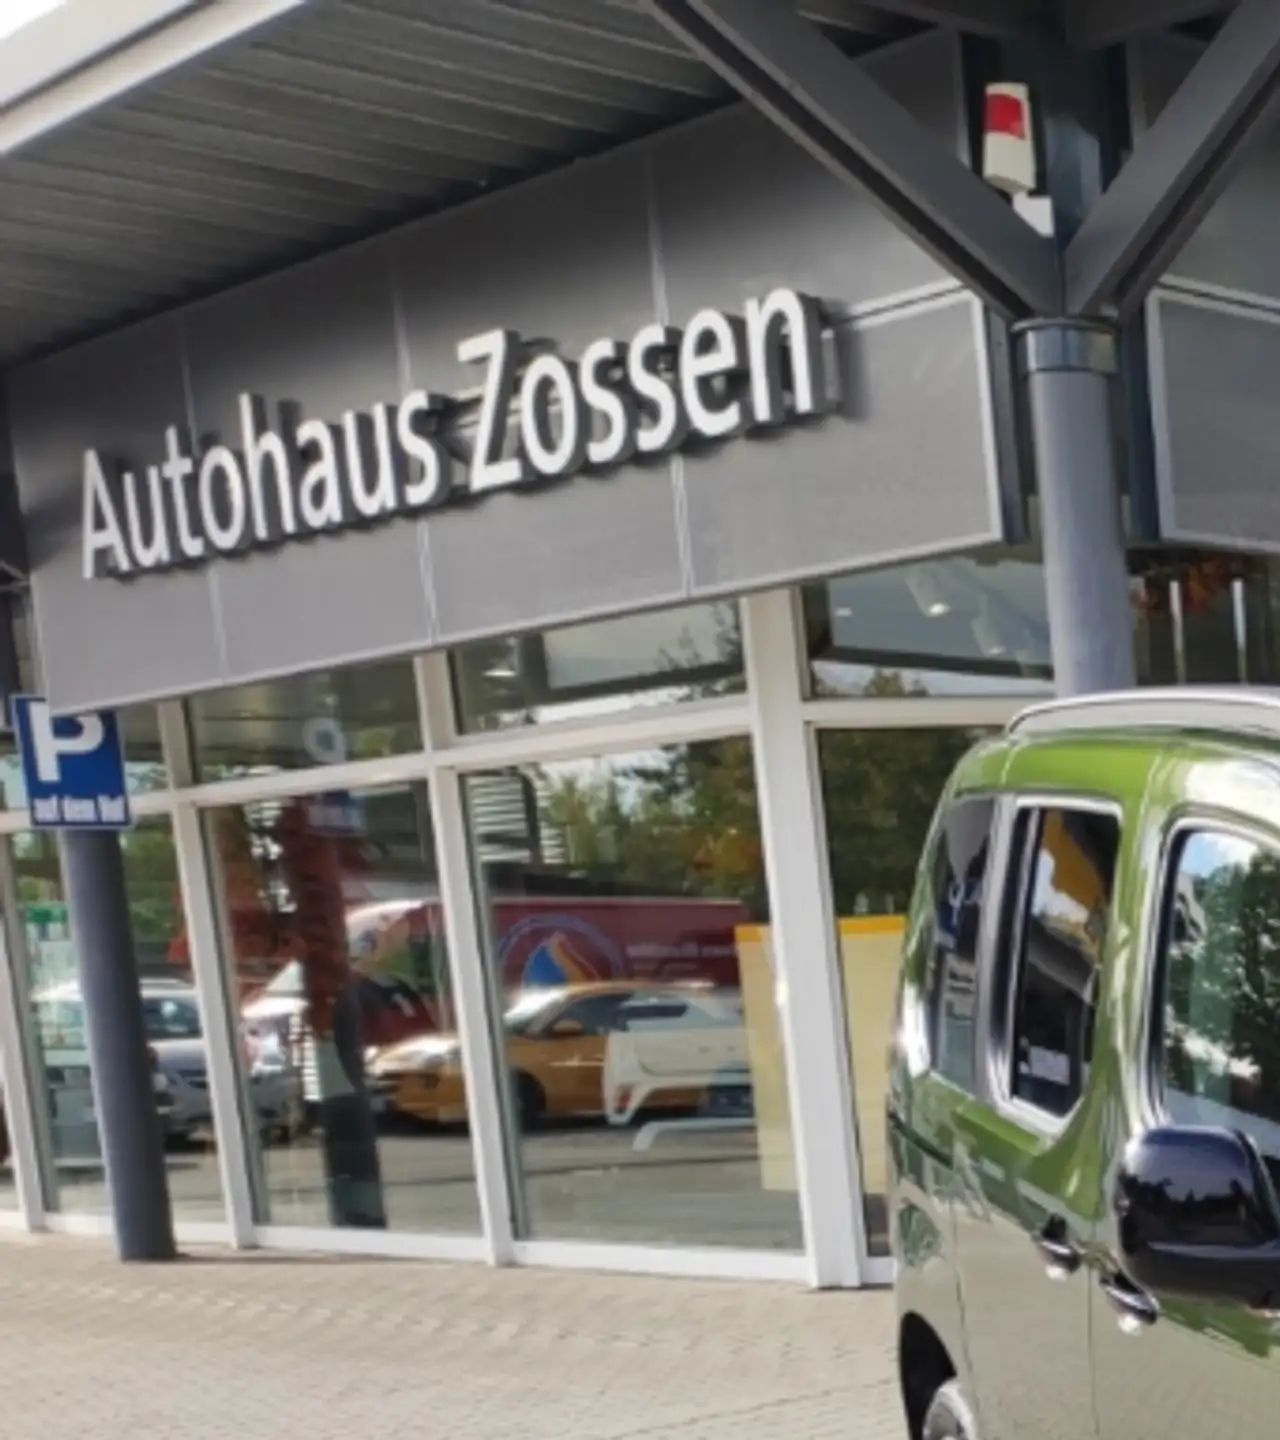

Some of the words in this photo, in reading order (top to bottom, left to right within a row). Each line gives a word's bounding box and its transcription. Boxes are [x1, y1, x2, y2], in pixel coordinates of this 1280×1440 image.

[81, 389, 443, 580] Autohaus
[456, 287, 816, 494] Zossen
[28, 701, 106, 782] P
